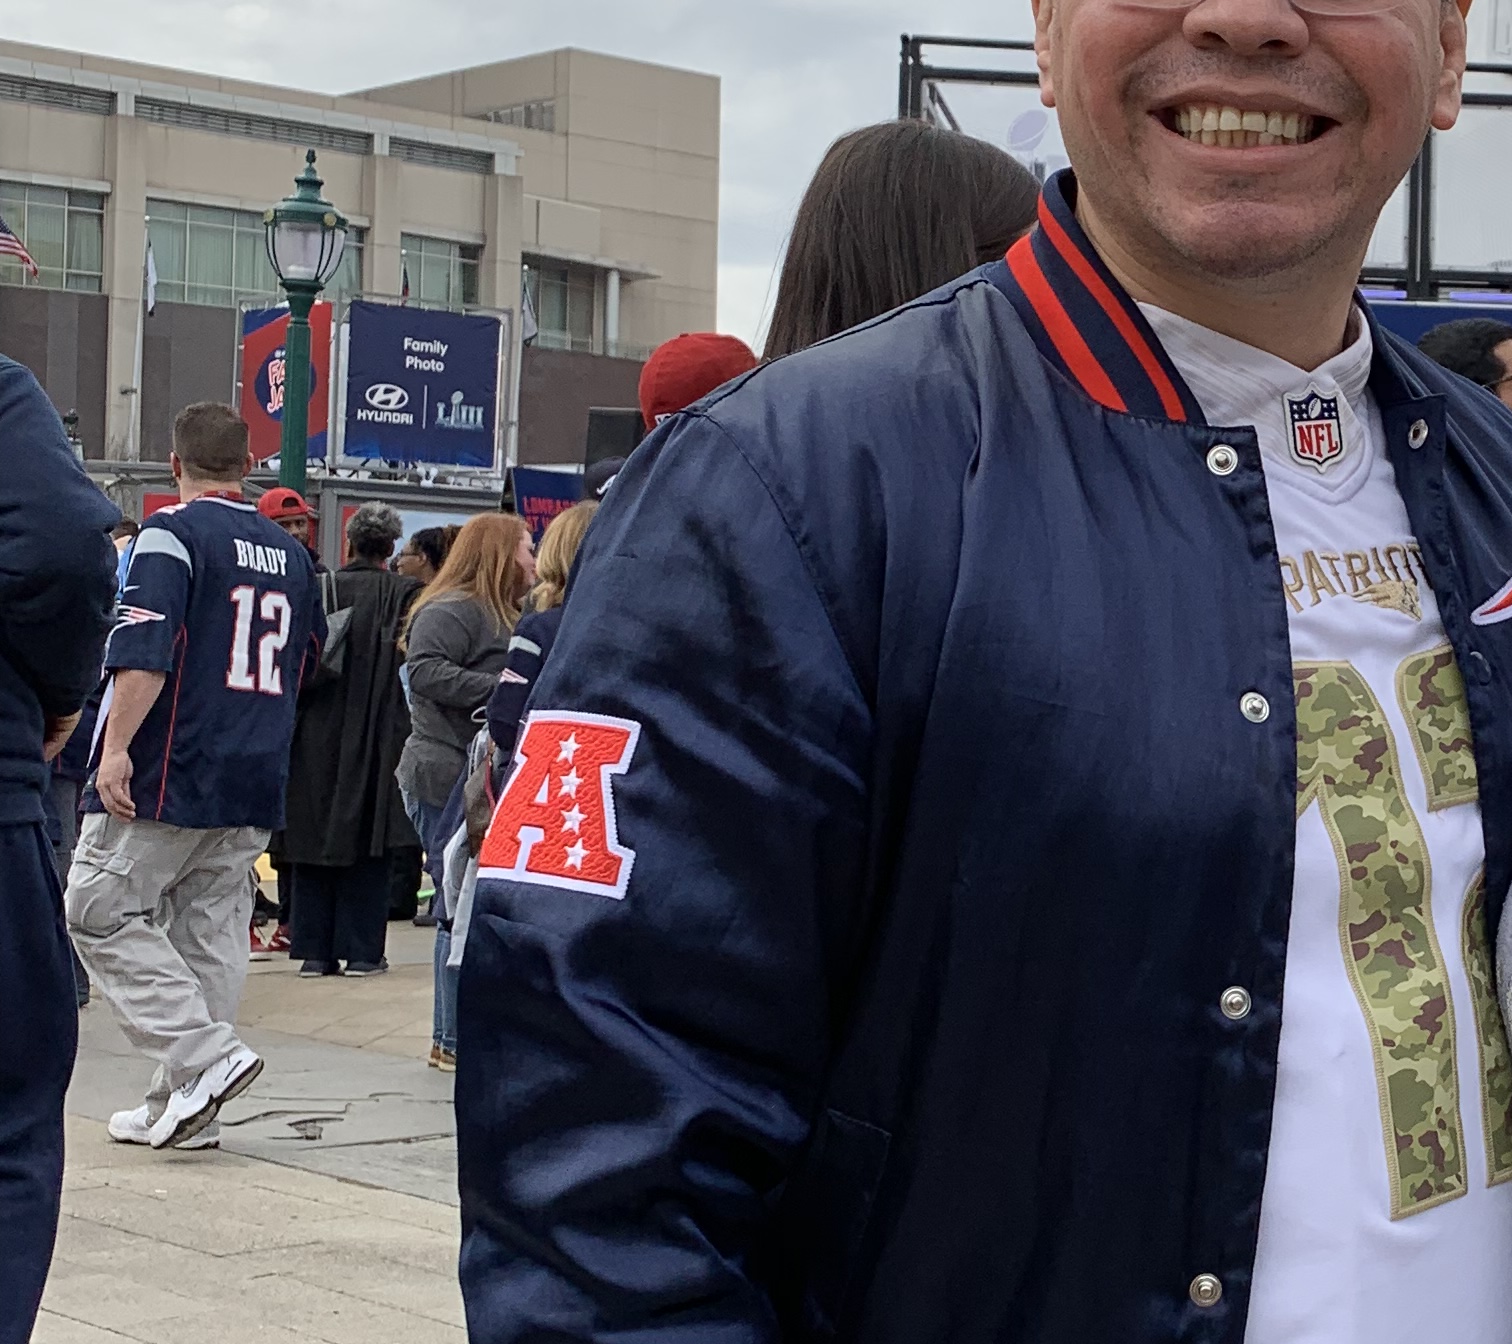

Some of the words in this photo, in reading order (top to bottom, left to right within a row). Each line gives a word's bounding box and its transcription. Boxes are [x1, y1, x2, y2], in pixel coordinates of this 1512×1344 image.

[403, 336, 449, 357] Family
[268, 359, 286, 386] FA
[405, 355, 445, 373] Photo
[267, 385, 285, 414] JA
[356, 409, 414, 425] HYUNDAI
[1297, 423, 1339, 457] NFL
[233, 538, 287, 577] BRADY
[1279, 540, 1435, 614] PATRIOT
[225, 585, 292, 695] 12
